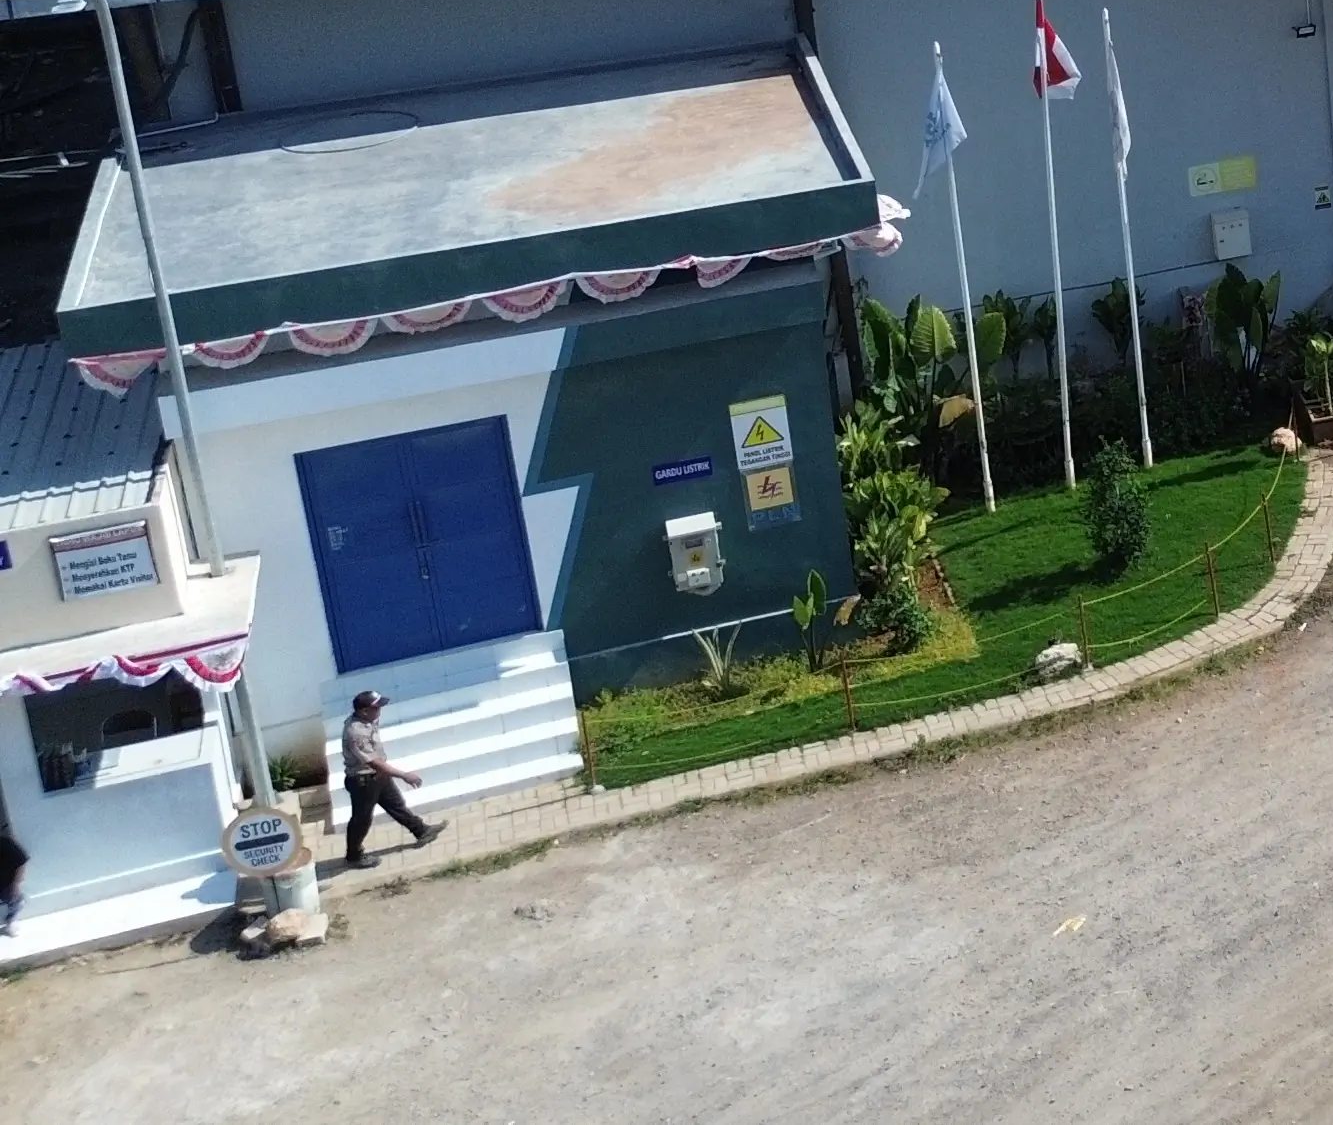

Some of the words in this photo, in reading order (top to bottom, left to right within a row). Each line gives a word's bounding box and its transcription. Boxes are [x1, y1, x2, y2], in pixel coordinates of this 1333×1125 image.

[762, 445, 784, 455] LISTRIK
[655, 467, 682, 480] GARDU
[683, 461, 710, 474] LISTRIK
[118, 552, 137, 562] Tamu
[121, 563, 135, 574] KTP
[108, 576, 129, 588] Kartu
[240, 818, 282, 838] STOP
[243, 843, 284, 860] SECURITY
[250, 854, 281, 867] CHECK
